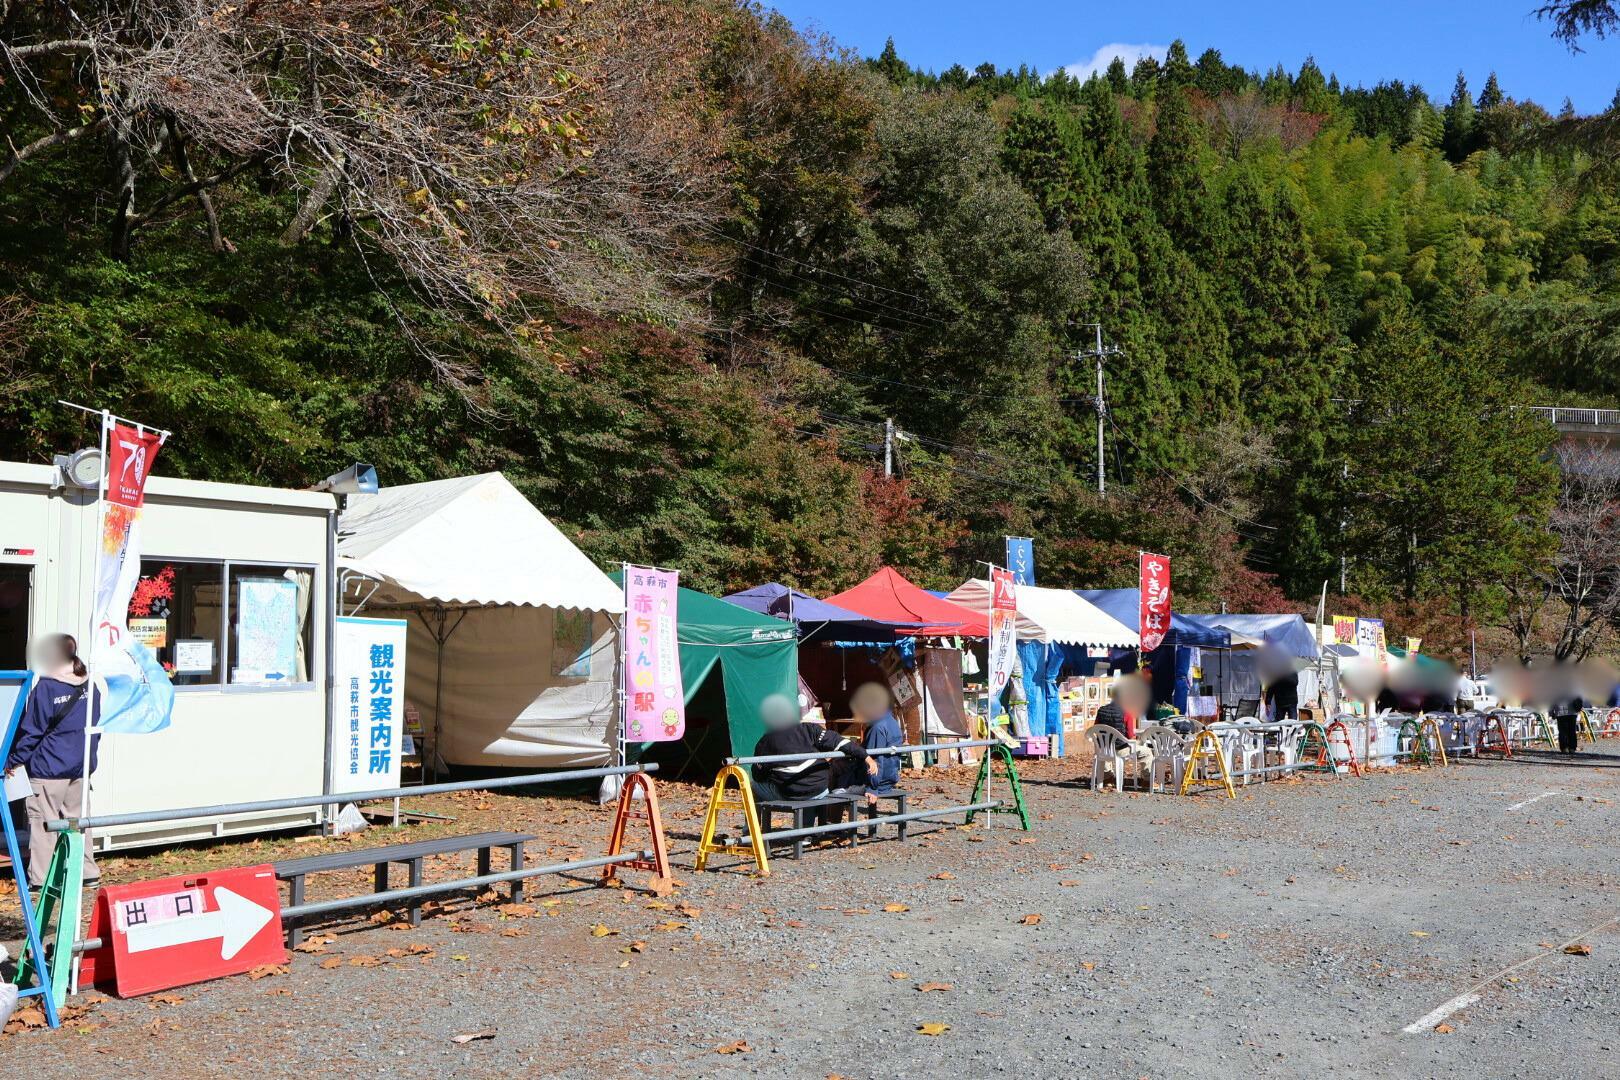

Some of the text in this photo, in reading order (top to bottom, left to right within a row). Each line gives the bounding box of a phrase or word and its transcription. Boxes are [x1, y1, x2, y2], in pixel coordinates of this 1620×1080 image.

[633, 574, 668, 590] 高萩市
[1145, 559, 1164, 630] やきそば
[633, 593, 655, 713] 赤ちゃんの駅
[349, 677, 360, 775] 高萩市観光協会
[369, 643, 395, 775] 観光案内所
[126, 895, 194, 927] 出口
